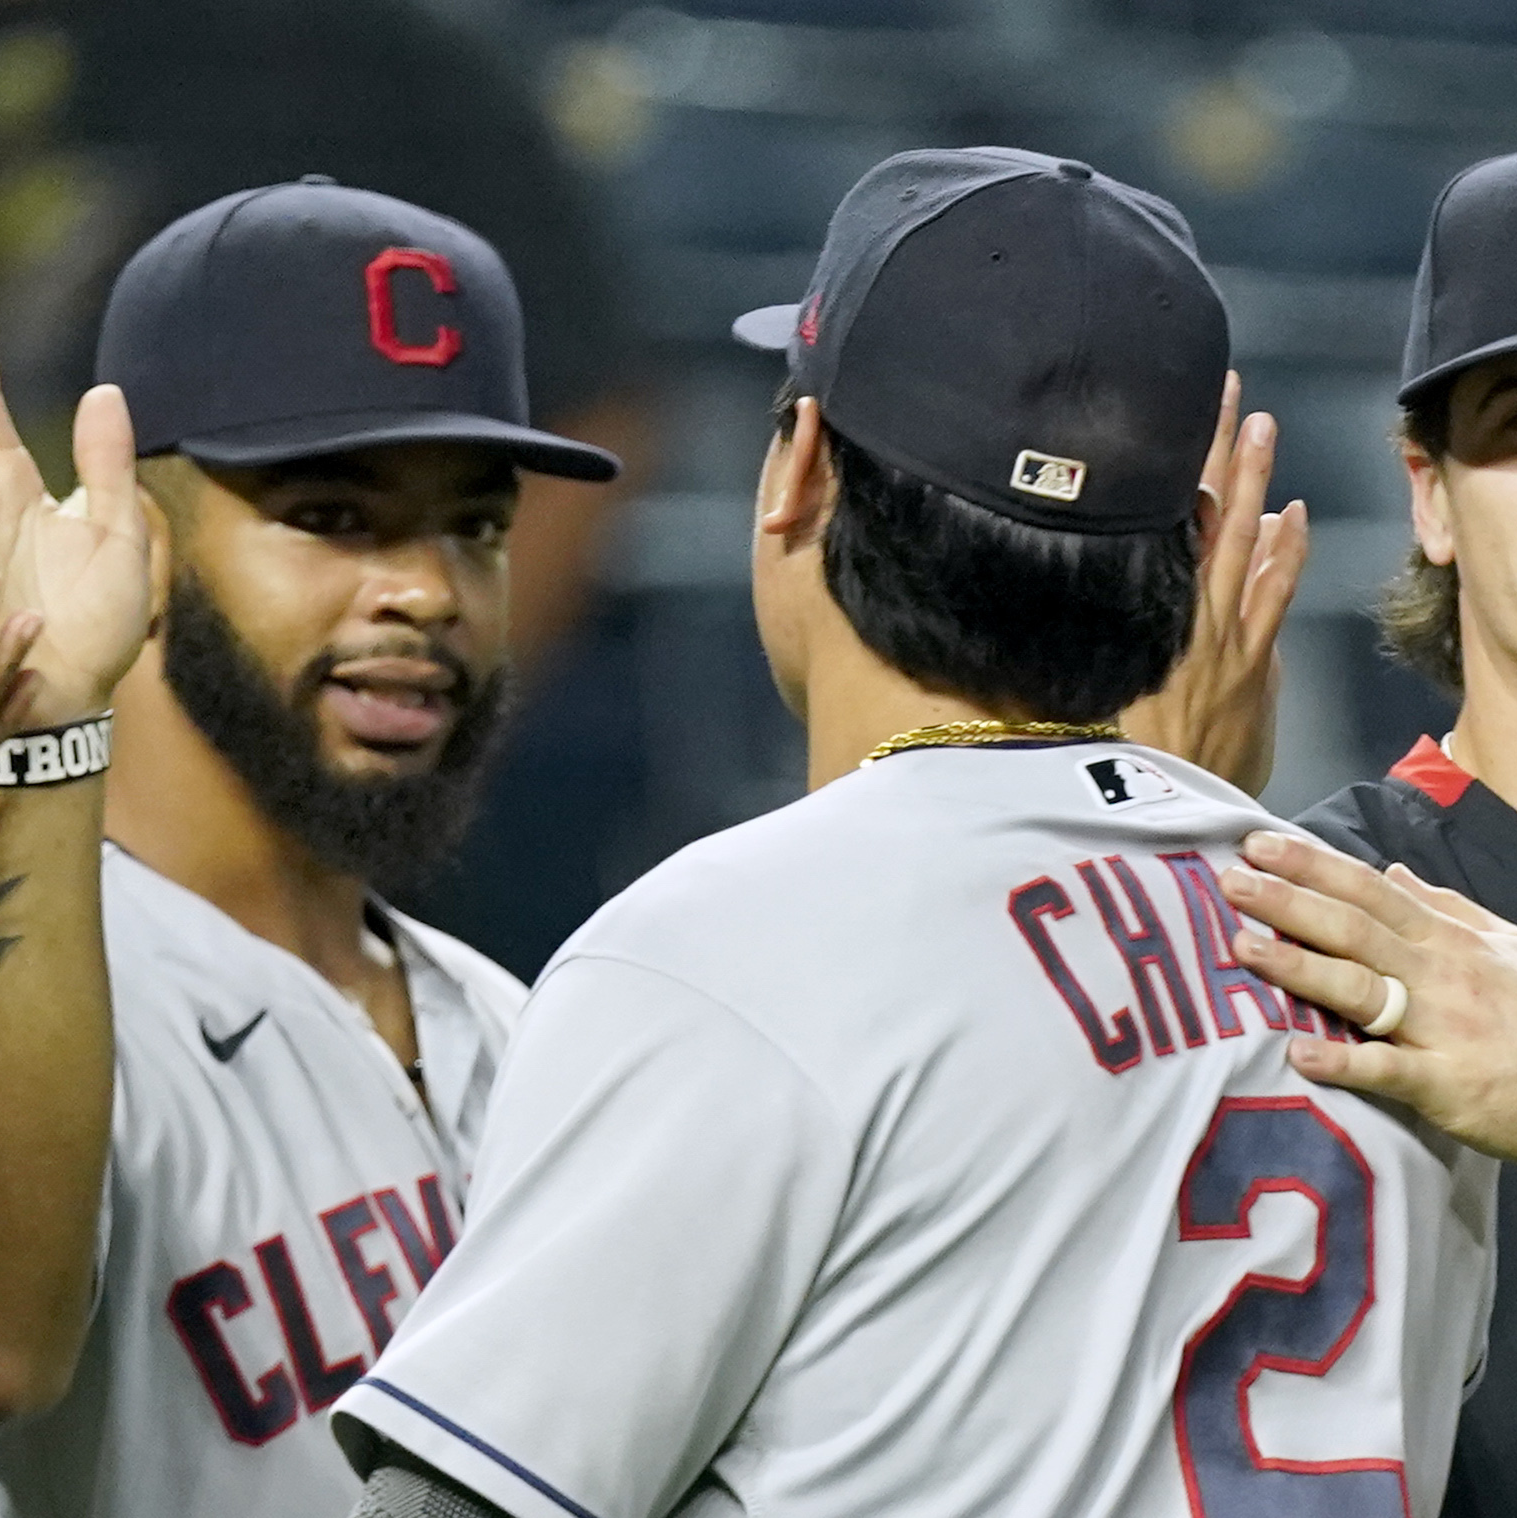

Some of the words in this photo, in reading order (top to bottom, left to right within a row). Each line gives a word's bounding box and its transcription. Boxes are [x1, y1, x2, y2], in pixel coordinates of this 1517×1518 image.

[365, 247, 462, 367] C
[1008, 850, 1396, 1076] CHA
[166, 1172, 472, 1448] CLEV
